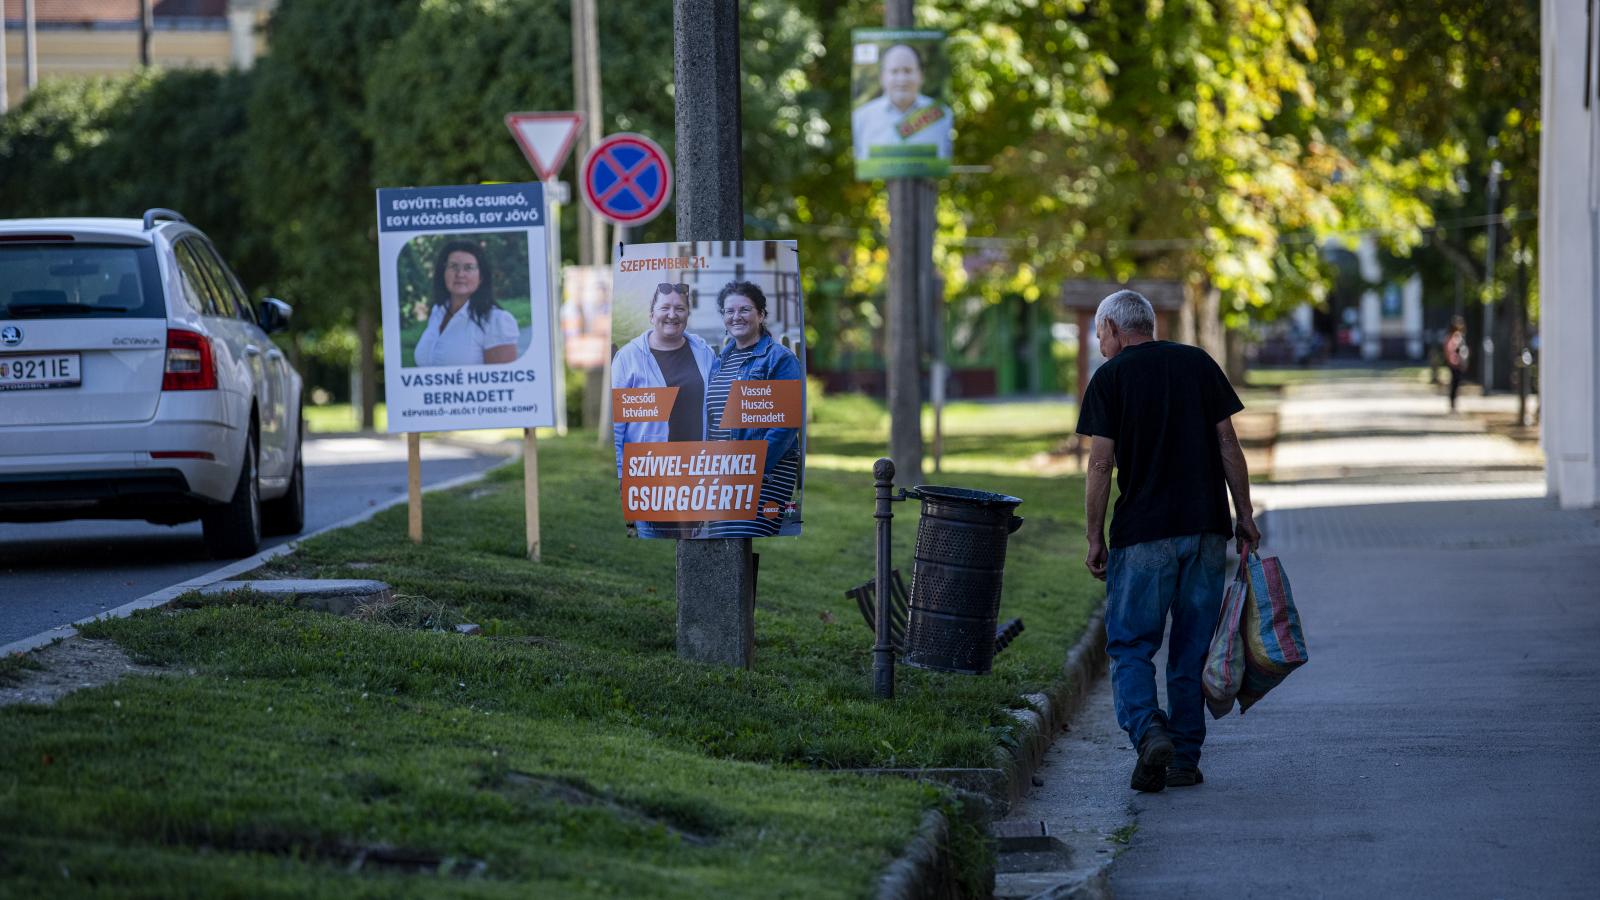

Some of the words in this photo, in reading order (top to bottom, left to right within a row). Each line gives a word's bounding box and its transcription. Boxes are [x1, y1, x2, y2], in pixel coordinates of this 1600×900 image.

[393, 196, 441, 211] EGYÜTT:
[442, 194, 473, 209] ERŐS
[475, 192, 529, 207] CSURGÓ,
[386, 215, 409, 227] EGY
[412, 211, 478, 226] KÖZÖSSÉG,
[480, 212, 503, 223] EGY
[505, 208, 539, 222] JÖVŐ
[620, 256, 689, 272] SZEPTEMBER
[692, 256, 710, 269] 21.
[401, 369, 464, 387] VASSNÉ
[468, 370, 536, 385] HUSZICS
[423, 389, 514, 405] BERNADETT
[622, 392, 656, 404] Szecsődi
[741, 384, 771, 396] Vassné
[622, 407, 659, 418] Istvánné
[741, 399, 774, 410] Huszics
[741, 412, 785, 423] Bernadett
[628, 449, 757, 477] SZÍVVEL-LÉLEKKEL
[628, 478, 754, 511] CSURGÓÉRT!
